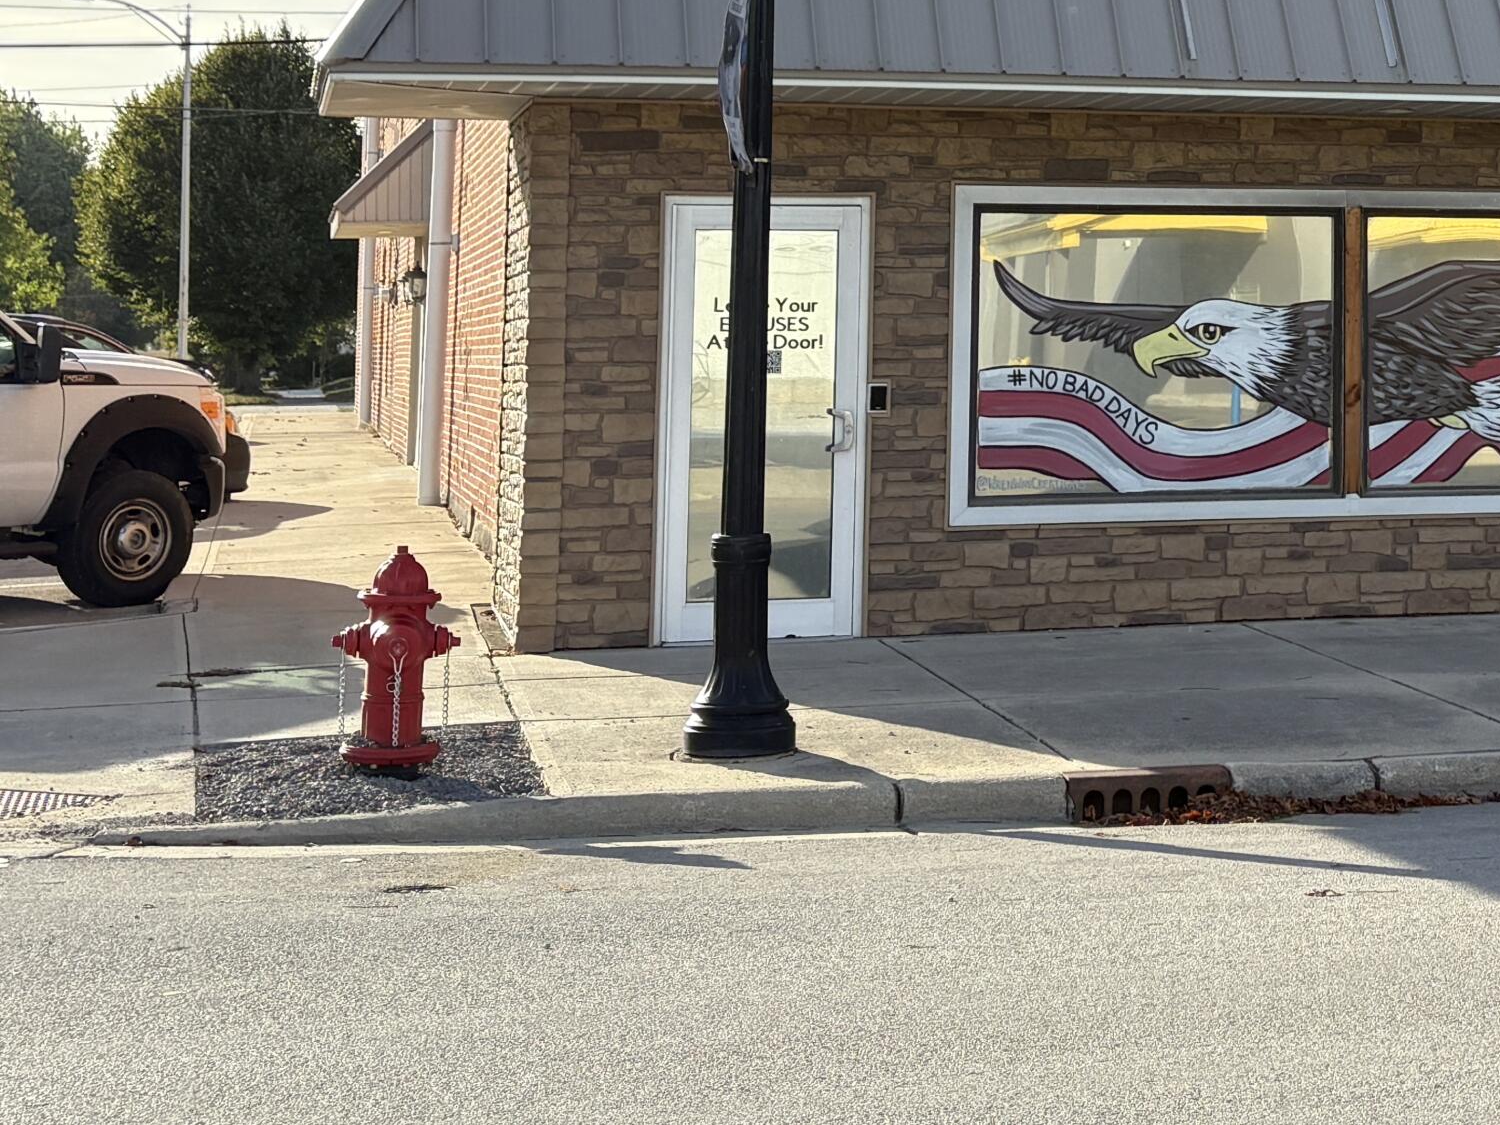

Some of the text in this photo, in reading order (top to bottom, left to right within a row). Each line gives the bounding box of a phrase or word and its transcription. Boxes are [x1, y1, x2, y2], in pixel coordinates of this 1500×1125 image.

[775, 297, 818, 312] Your
[720, 317, 809, 331] EUSES
[773, 334, 823, 349] Door!
[1007, 369, 1158, 445] #NO BAD DAYS
